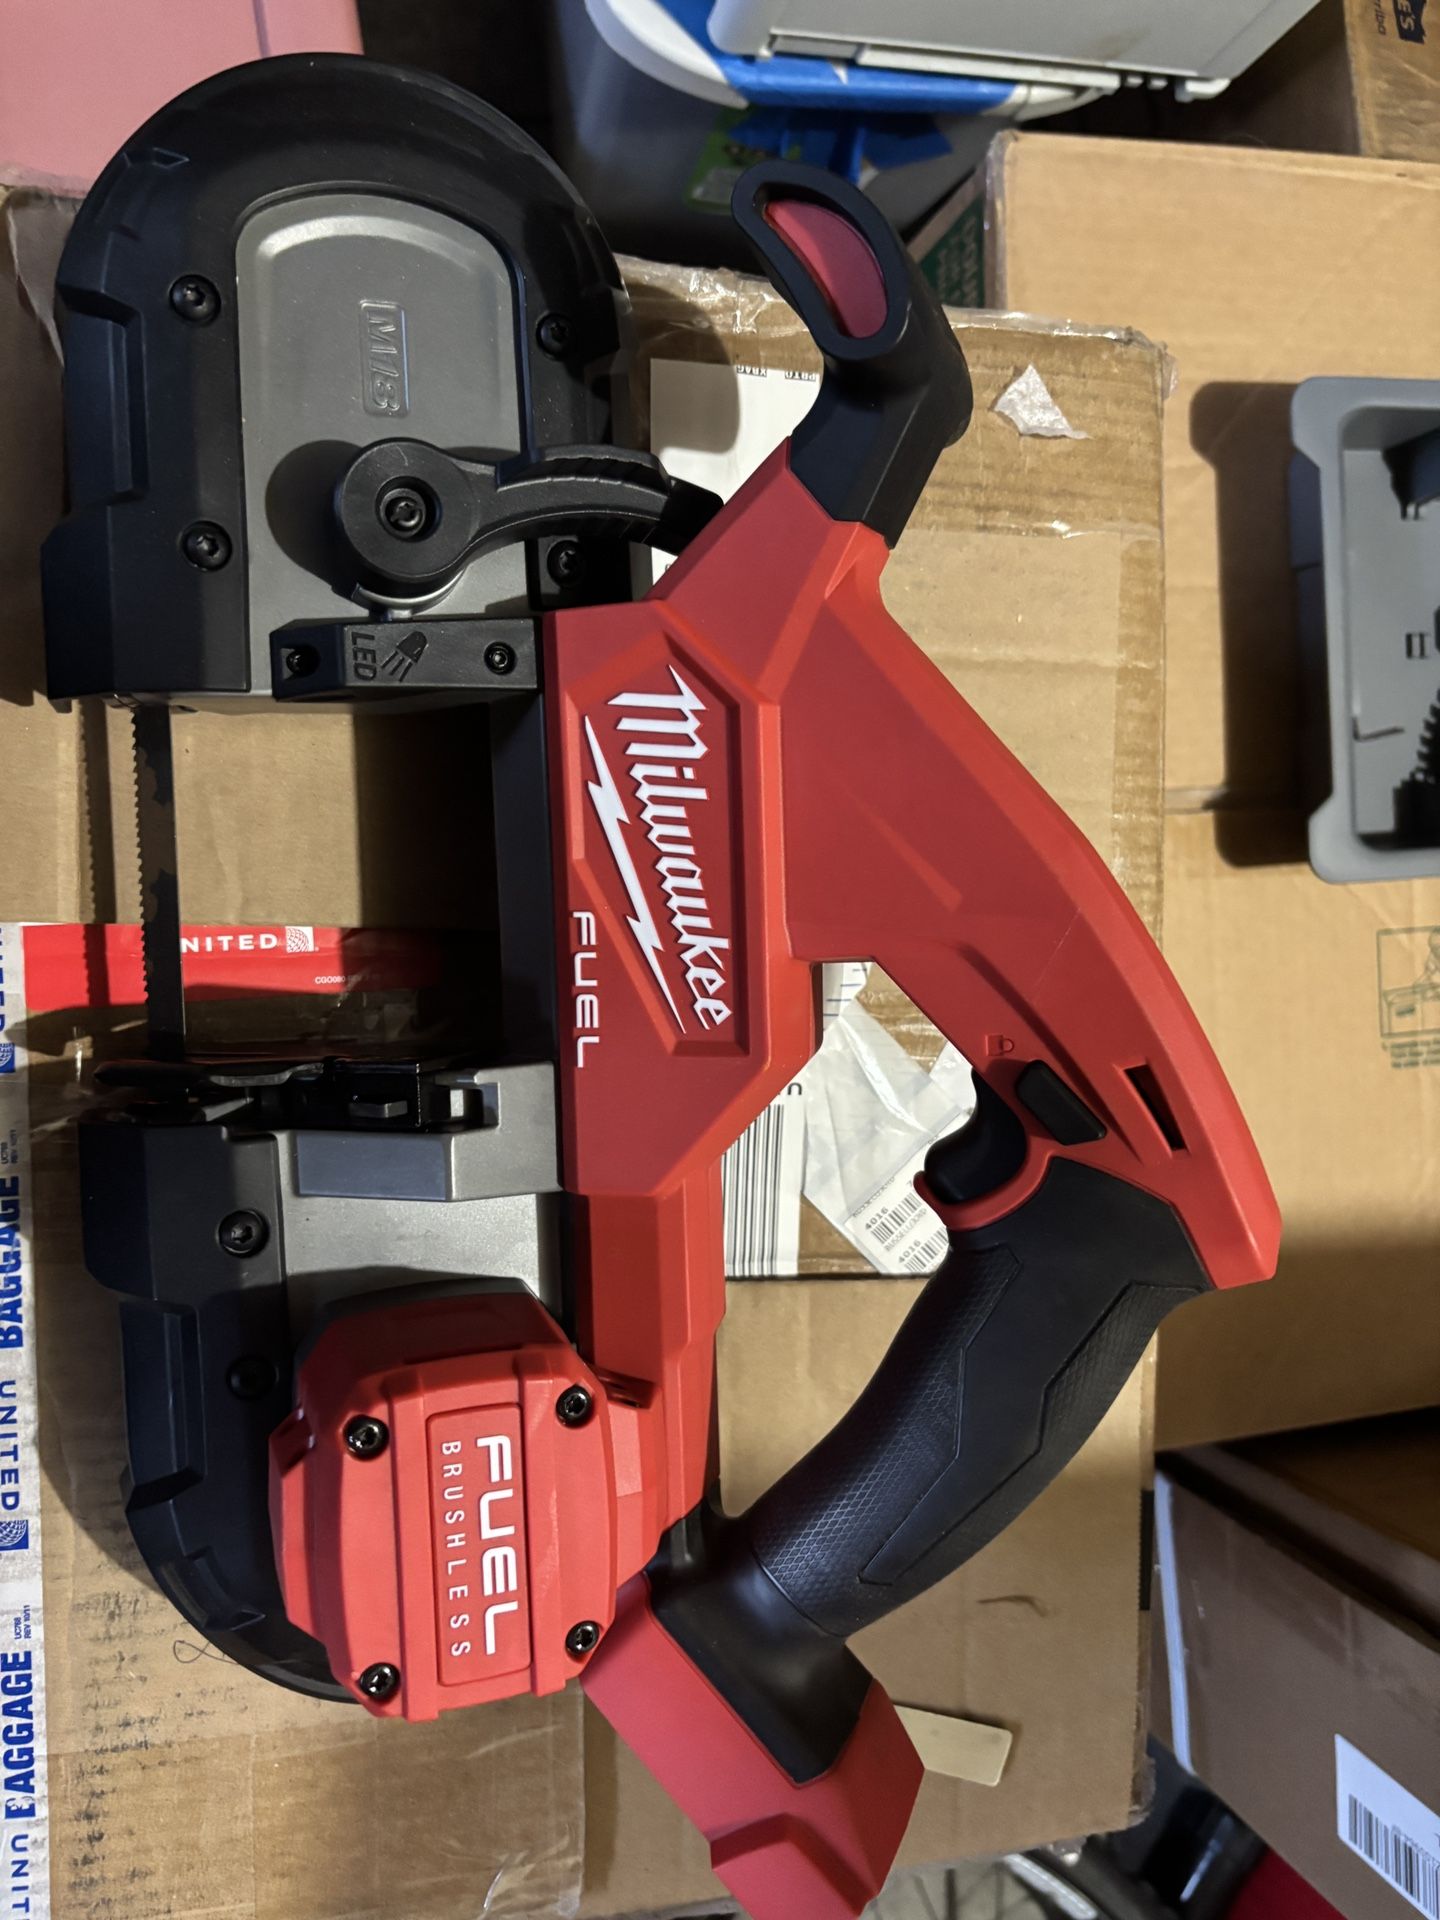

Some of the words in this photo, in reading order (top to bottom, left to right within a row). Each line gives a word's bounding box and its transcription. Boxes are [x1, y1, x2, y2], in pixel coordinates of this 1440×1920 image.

[367, 311, 399, 411] M18
[351, 631, 376, 680] LED
[607, 664, 733, 1031] Milwaukee
[180, 933, 278, 953] NITED
[573, 911, 600, 1068] FUEL
[0, 1176, 23, 1348] BAGGAGE
[865, 1207, 889, 1230] 4016
[899, 1239, 921, 1264] 4016
[0, 1379, 20, 1511] UNITED
[441, 1440, 471, 1657] BRUSHLESS
[476, 1434, 518, 1656] FUEL
[11, 1833, 30, 1920] UNIT
